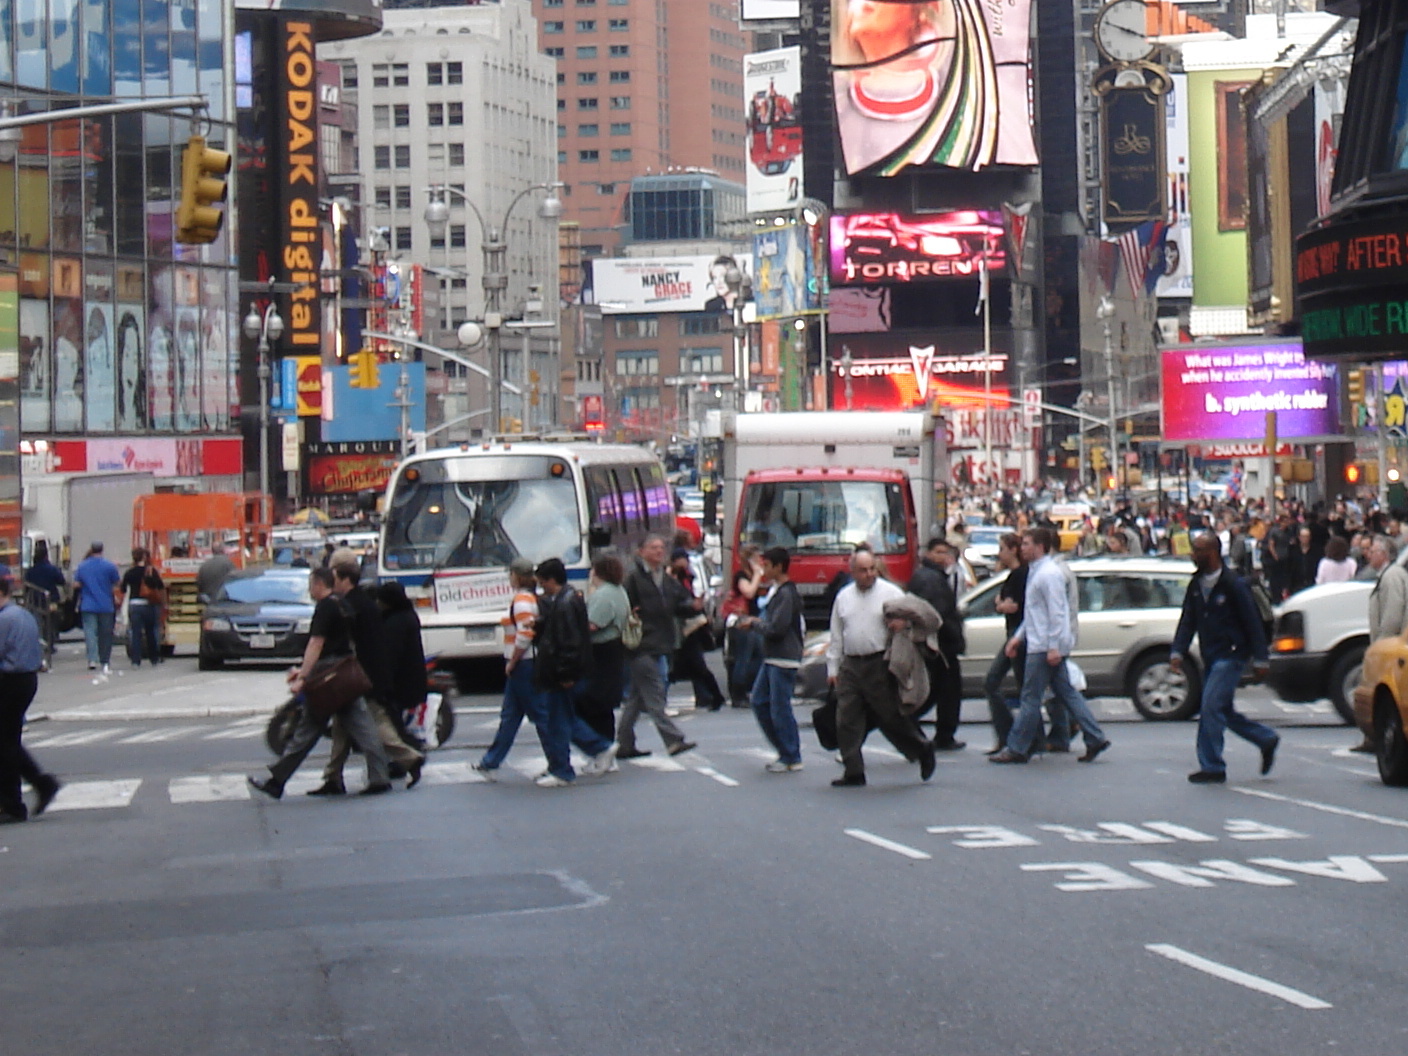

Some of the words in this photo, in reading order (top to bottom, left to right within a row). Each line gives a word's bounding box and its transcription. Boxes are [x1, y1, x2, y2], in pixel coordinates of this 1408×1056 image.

[285, 21, 314, 185] KODAK
[1347, 234, 1402, 271] AFTER
[284, 198, 320, 345] digital
[841, 257, 975, 280] TORREN
[642, 271, 680, 288] NANCY
[654, 281, 693, 298] GRACE
[1185, 354, 1213, 369] What
[1213, 355, 1232, 366] was
[1233, 353, 1264, 366] James
[1264, 350, 1293, 368] Wright
[1181, 369, 1210, 384] when
[1210, 369, 1224, 382] he
[1223, 391, 1292, 416] synthetic
[1292, 389, 1329, 410] rubber
[308, 441, 395, 454] MARQUI
[439, 590, 461, 603] old
